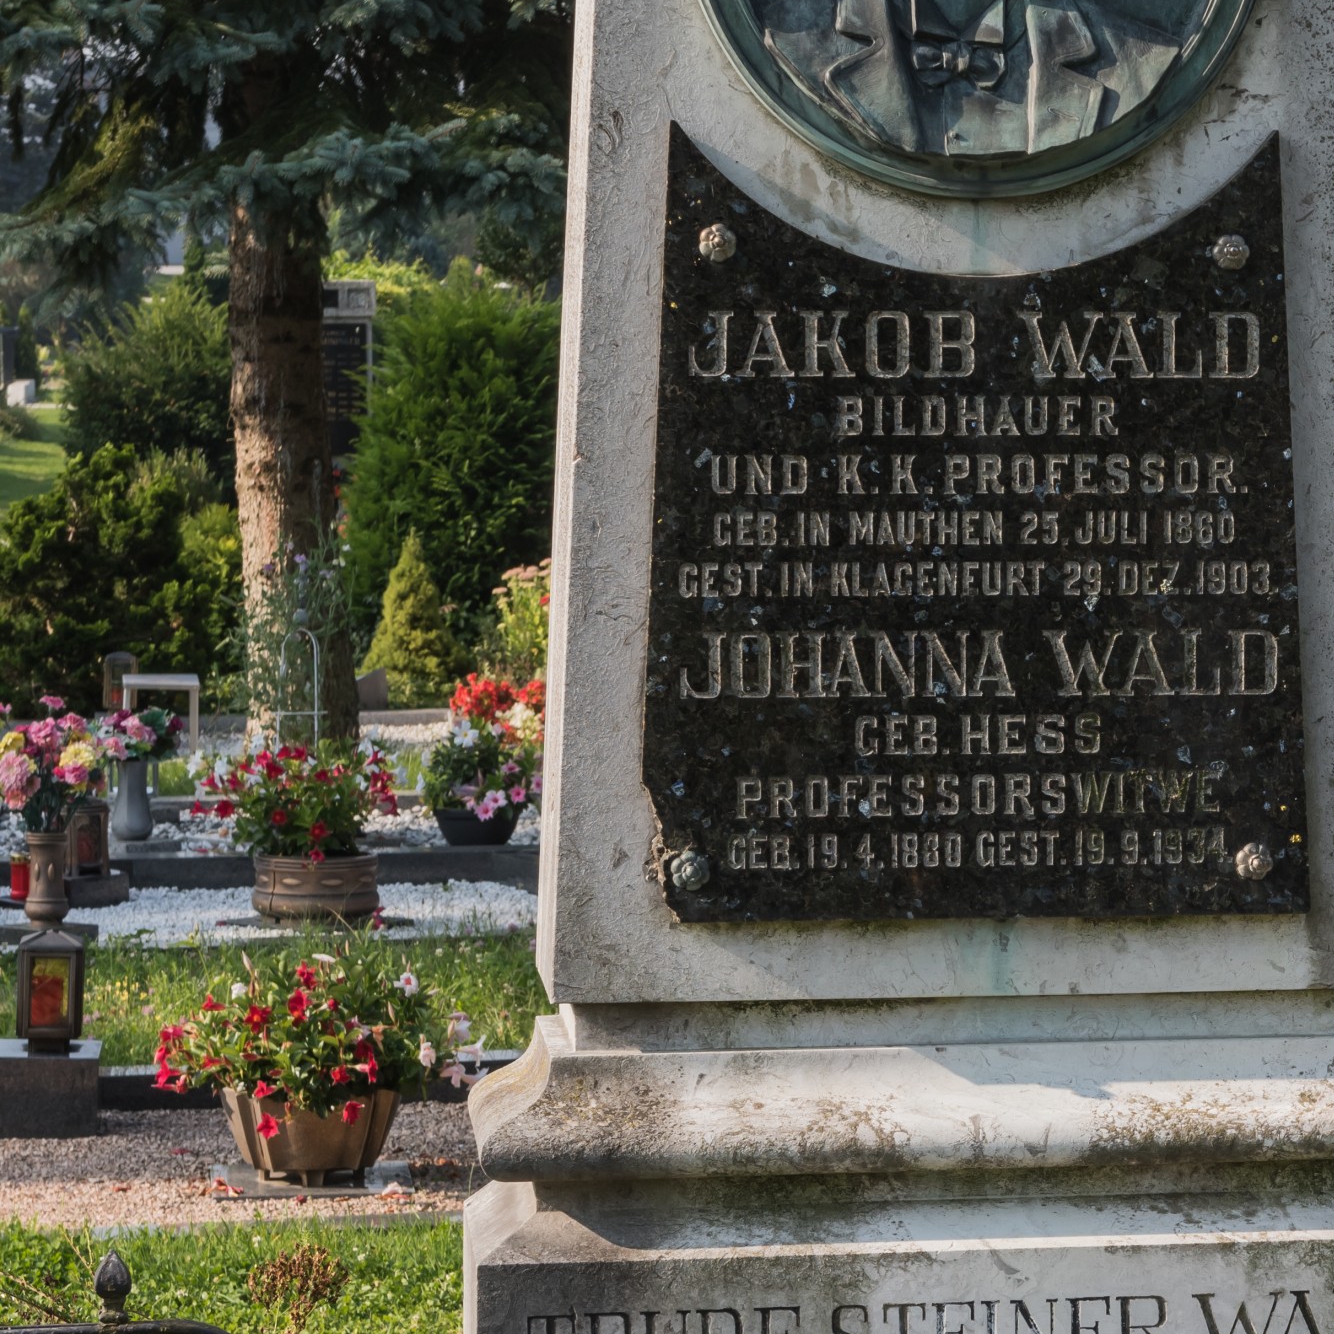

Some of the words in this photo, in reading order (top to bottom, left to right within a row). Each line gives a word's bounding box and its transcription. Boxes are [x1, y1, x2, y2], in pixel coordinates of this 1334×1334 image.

[688, 310, 976, 379] JAKOB
[1017, 310, 1261, 379] WALD
[836, 395, 1119, 437] BILDHAUER
[711, 454, 808, 495] UND
[849, 510, 1003, 546] MAUTHEN
[1163, 510, 1235, 545] 1860
[830, 560, 1045, 597] KLAGENFURT
[680, 629, 1016, 700] JOHANNA
[1043, 628, 1279, 697] WALD
[735, 769, 1220, 819] PROFESSORSWITWE
